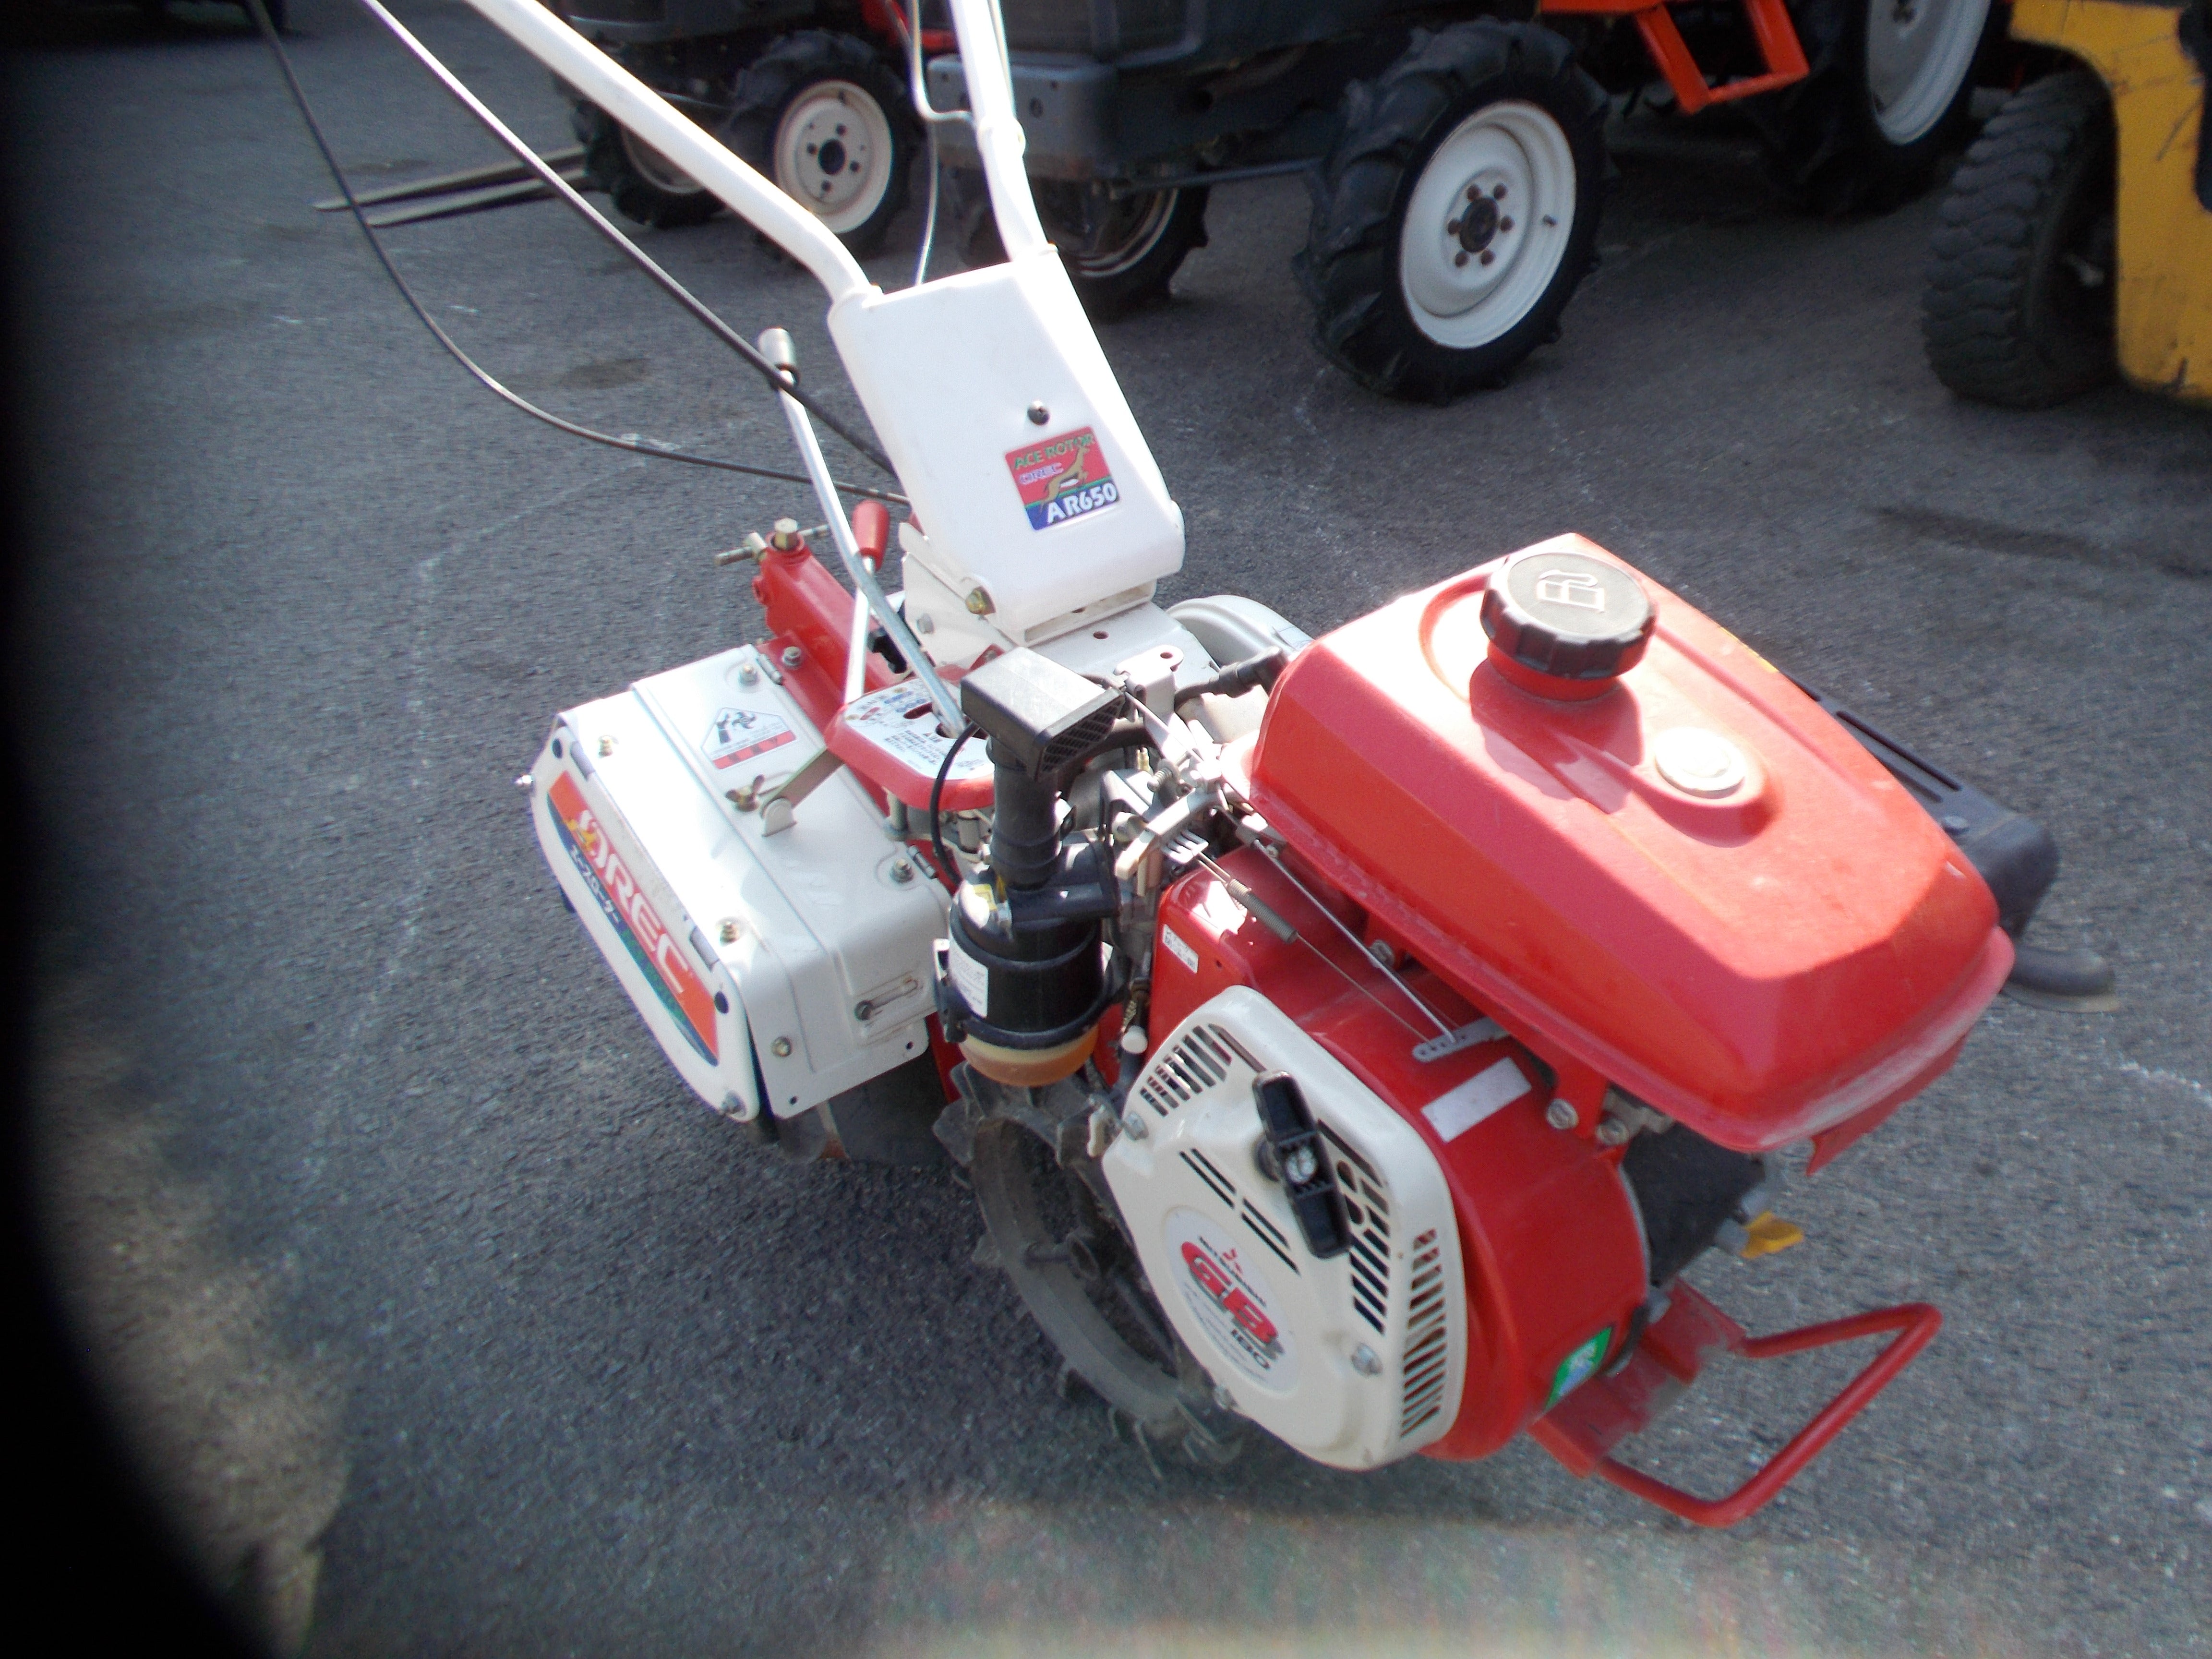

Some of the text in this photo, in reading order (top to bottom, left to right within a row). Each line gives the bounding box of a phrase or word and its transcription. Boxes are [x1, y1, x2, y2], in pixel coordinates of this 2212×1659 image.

[1014, 450, 1043, 469] ACE
[1047, 482, 1117, 524] AR650
[1181, 1241, 1280, 1346] GB
